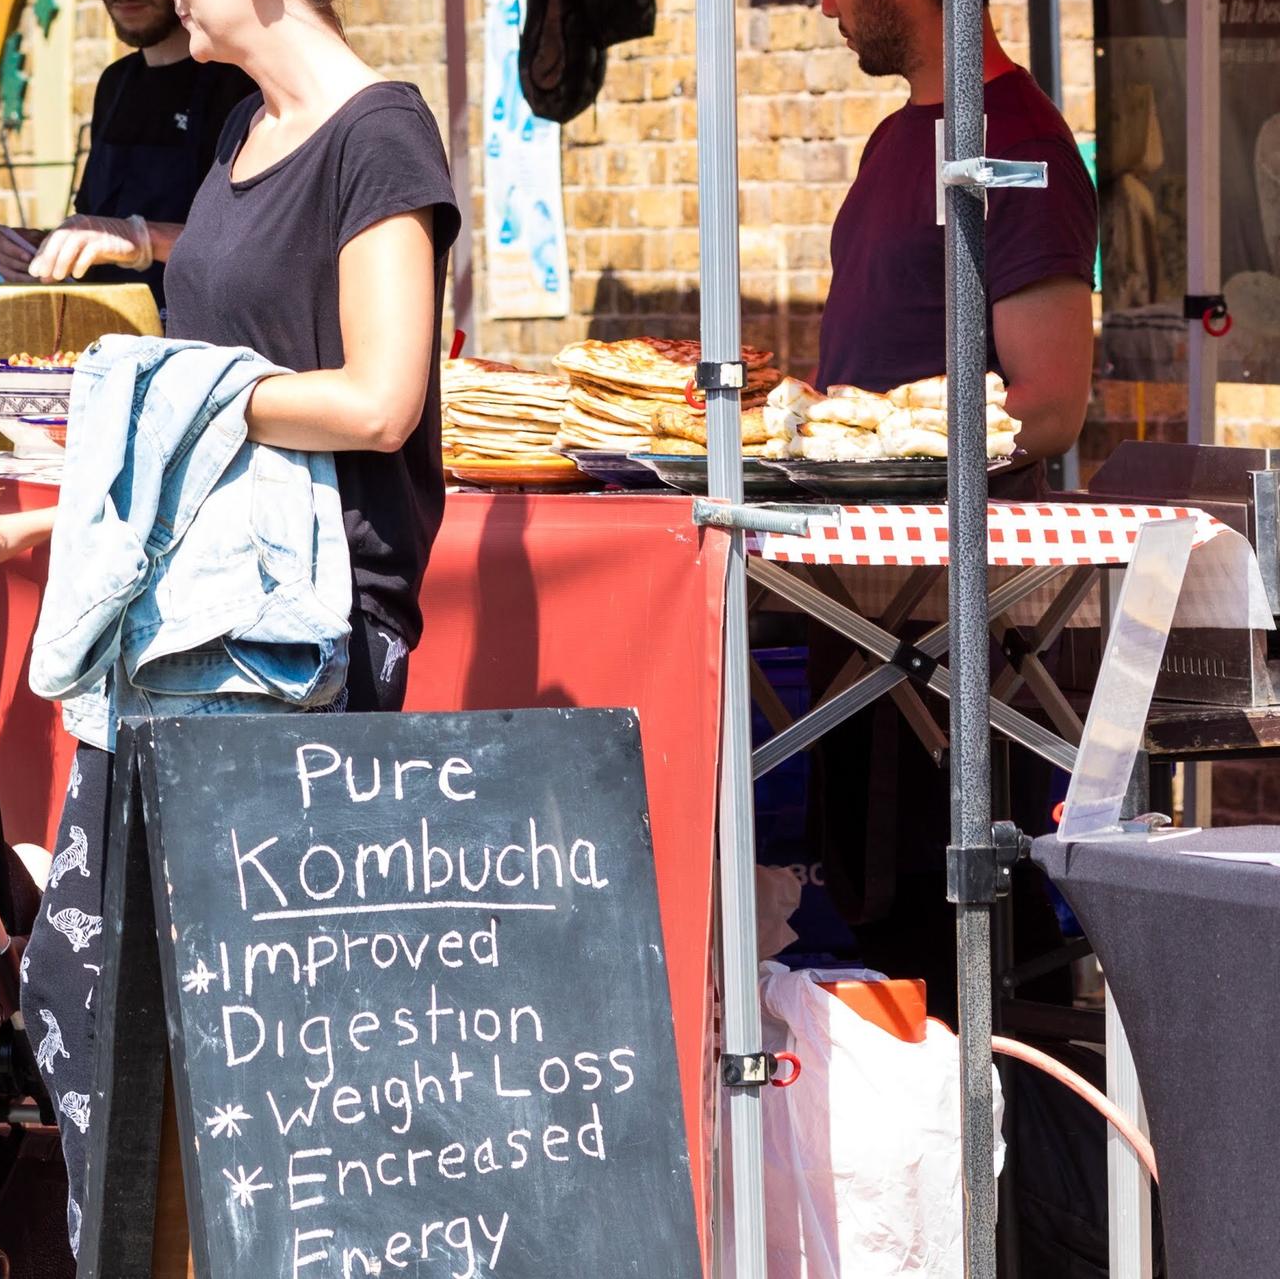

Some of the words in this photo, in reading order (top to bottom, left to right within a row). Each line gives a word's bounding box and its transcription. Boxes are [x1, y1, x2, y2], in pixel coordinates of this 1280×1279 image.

[296, 743, 476, 809] Pure
[231, 817, 609, 909] Kombucha
[219, 918, 499, 996] Improved
[222, 984, 544, 1090] Digestion
[266, 1051, 474, 1136] Weight
[494, 1046, 636, 1098] Loss
[287, 1103, 607, 1211] Encreased
